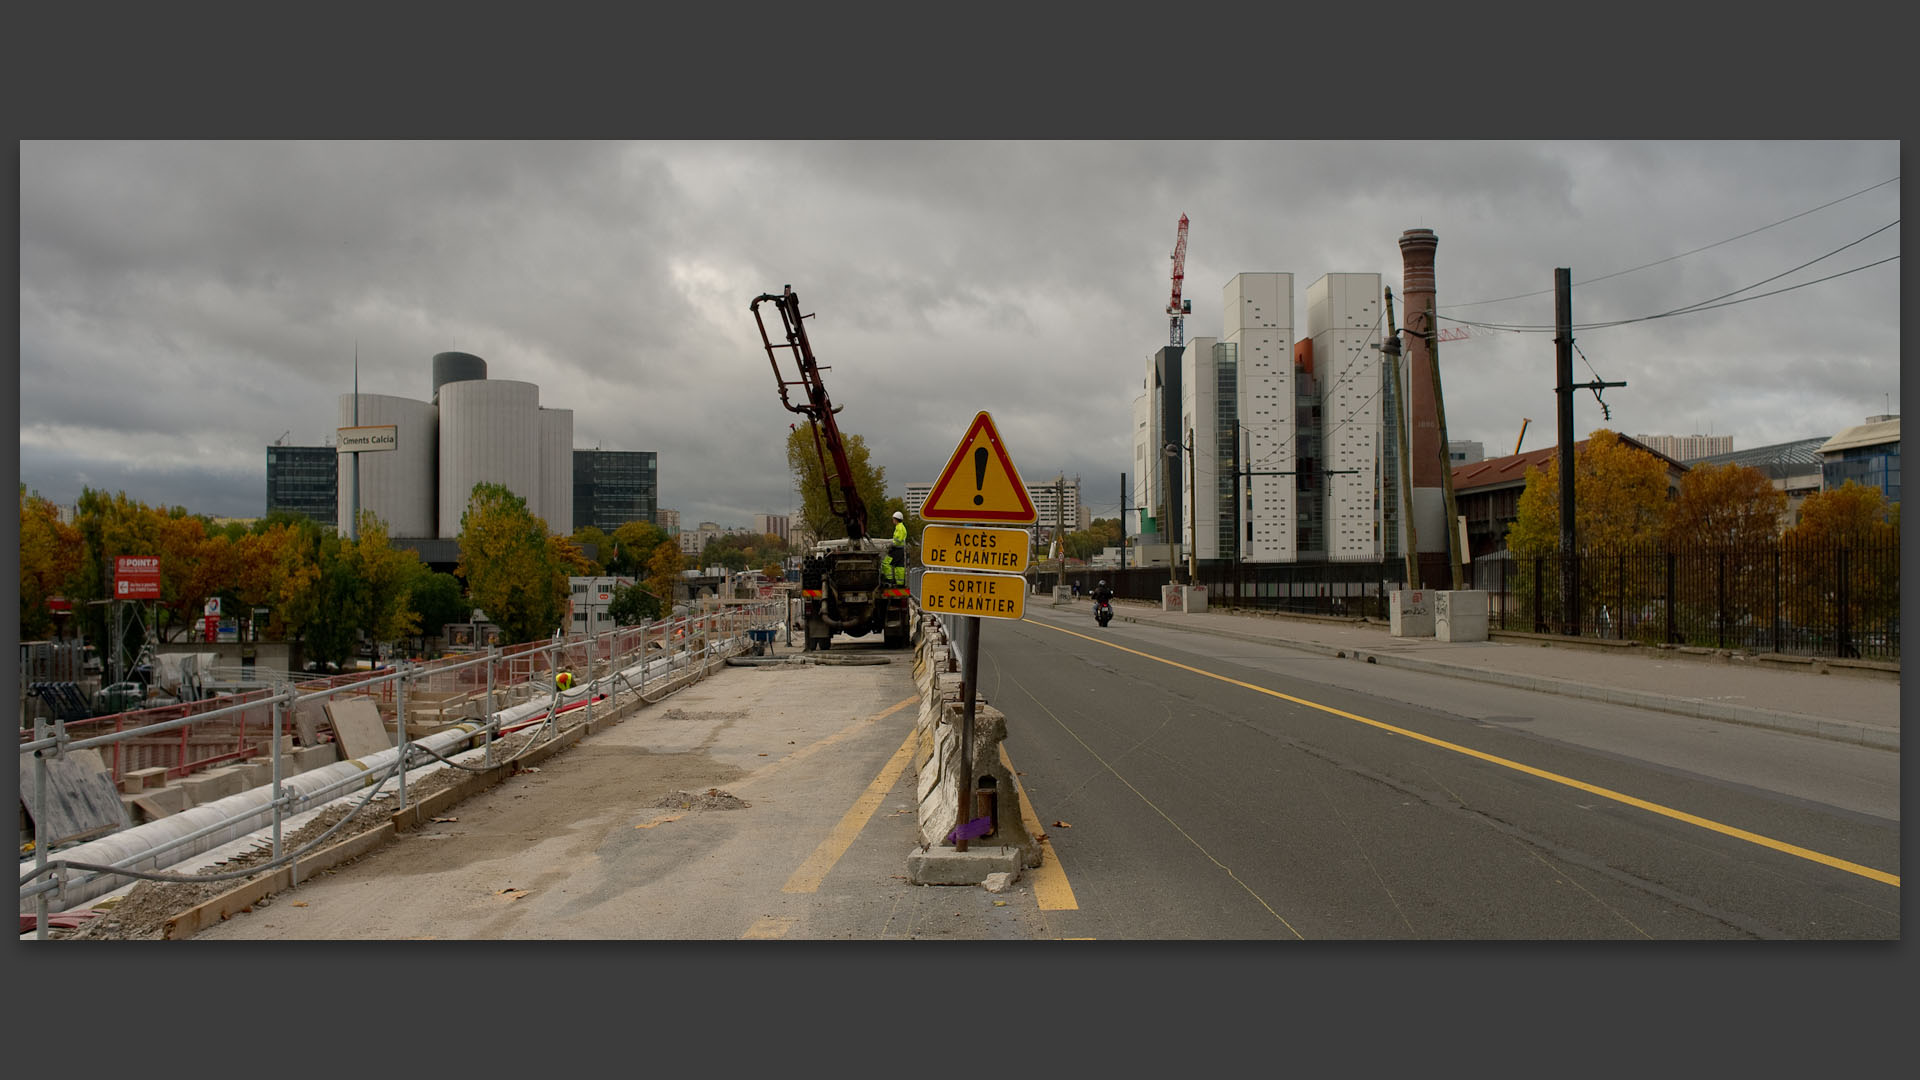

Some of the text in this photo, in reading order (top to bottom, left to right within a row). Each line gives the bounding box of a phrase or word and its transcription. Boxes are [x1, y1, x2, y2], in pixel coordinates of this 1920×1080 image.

[343, 435, 394, 445] Ciments Calcia
[954, 532, 997, 548] ACCÈS
[931, 549, 1018, 566] DE CHANTIER
[949, 579, 996, 594] SORTIE
[929, 595, 1015, 613] DE CHANTIER
